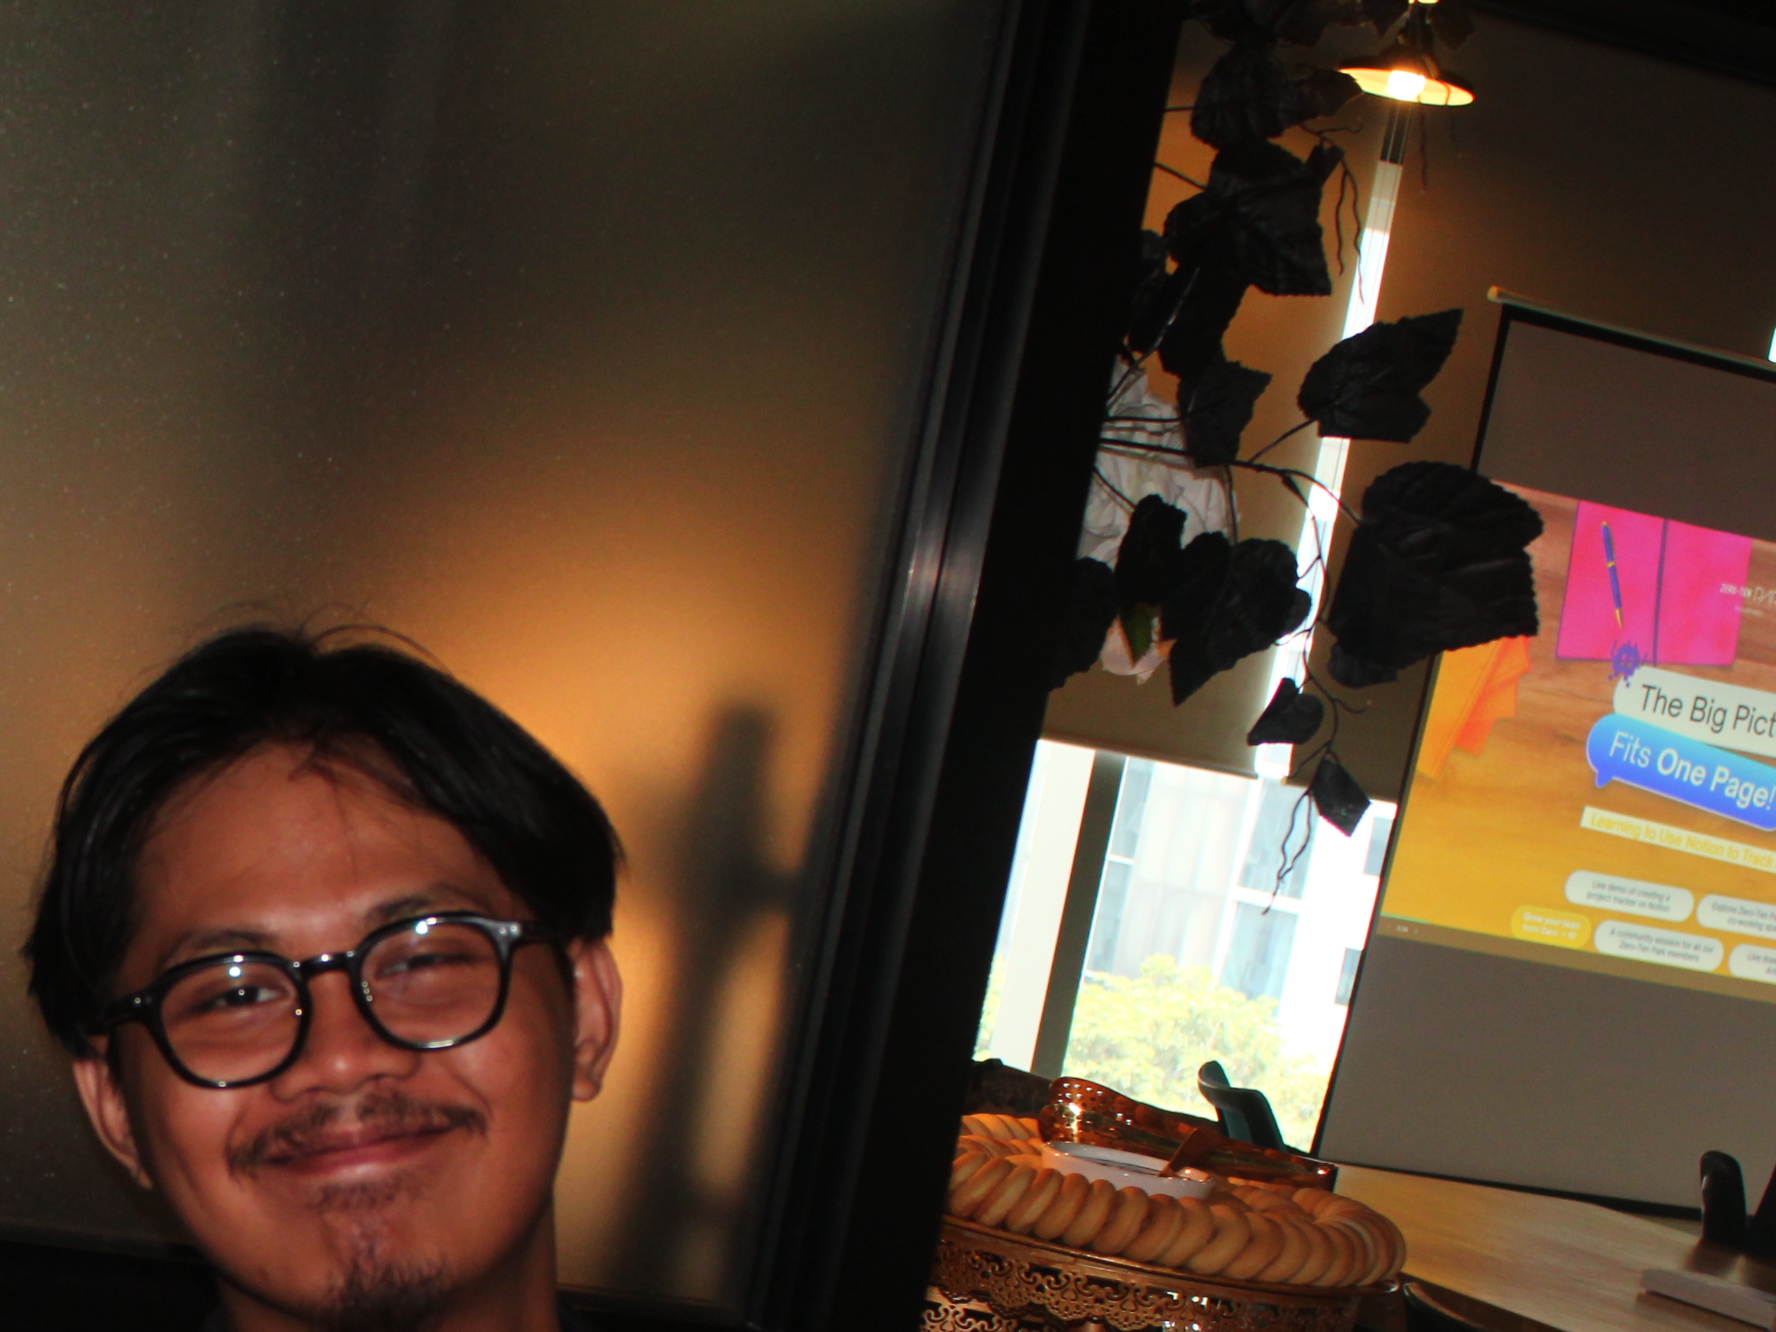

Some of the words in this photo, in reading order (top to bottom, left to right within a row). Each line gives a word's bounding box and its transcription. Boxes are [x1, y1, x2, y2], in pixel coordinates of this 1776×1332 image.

[1642, 684, 1683, 718] The
[1689, 696, 1727, 734] Big
[1609, 731, 1652, 768] Fits
[1657, 748, 1707, 786] One
[1710, 765, 1776, 811] Page!
[1590, 812, 1642, 841] Learning
[1644, 826, 1657, 841] to
[1659, 829, 1683, 847] Use
[1685, 836, 1724, 856] Notion
[1726, 845, 1740, 860] to
[1742, 849, 1774, 868] Track
